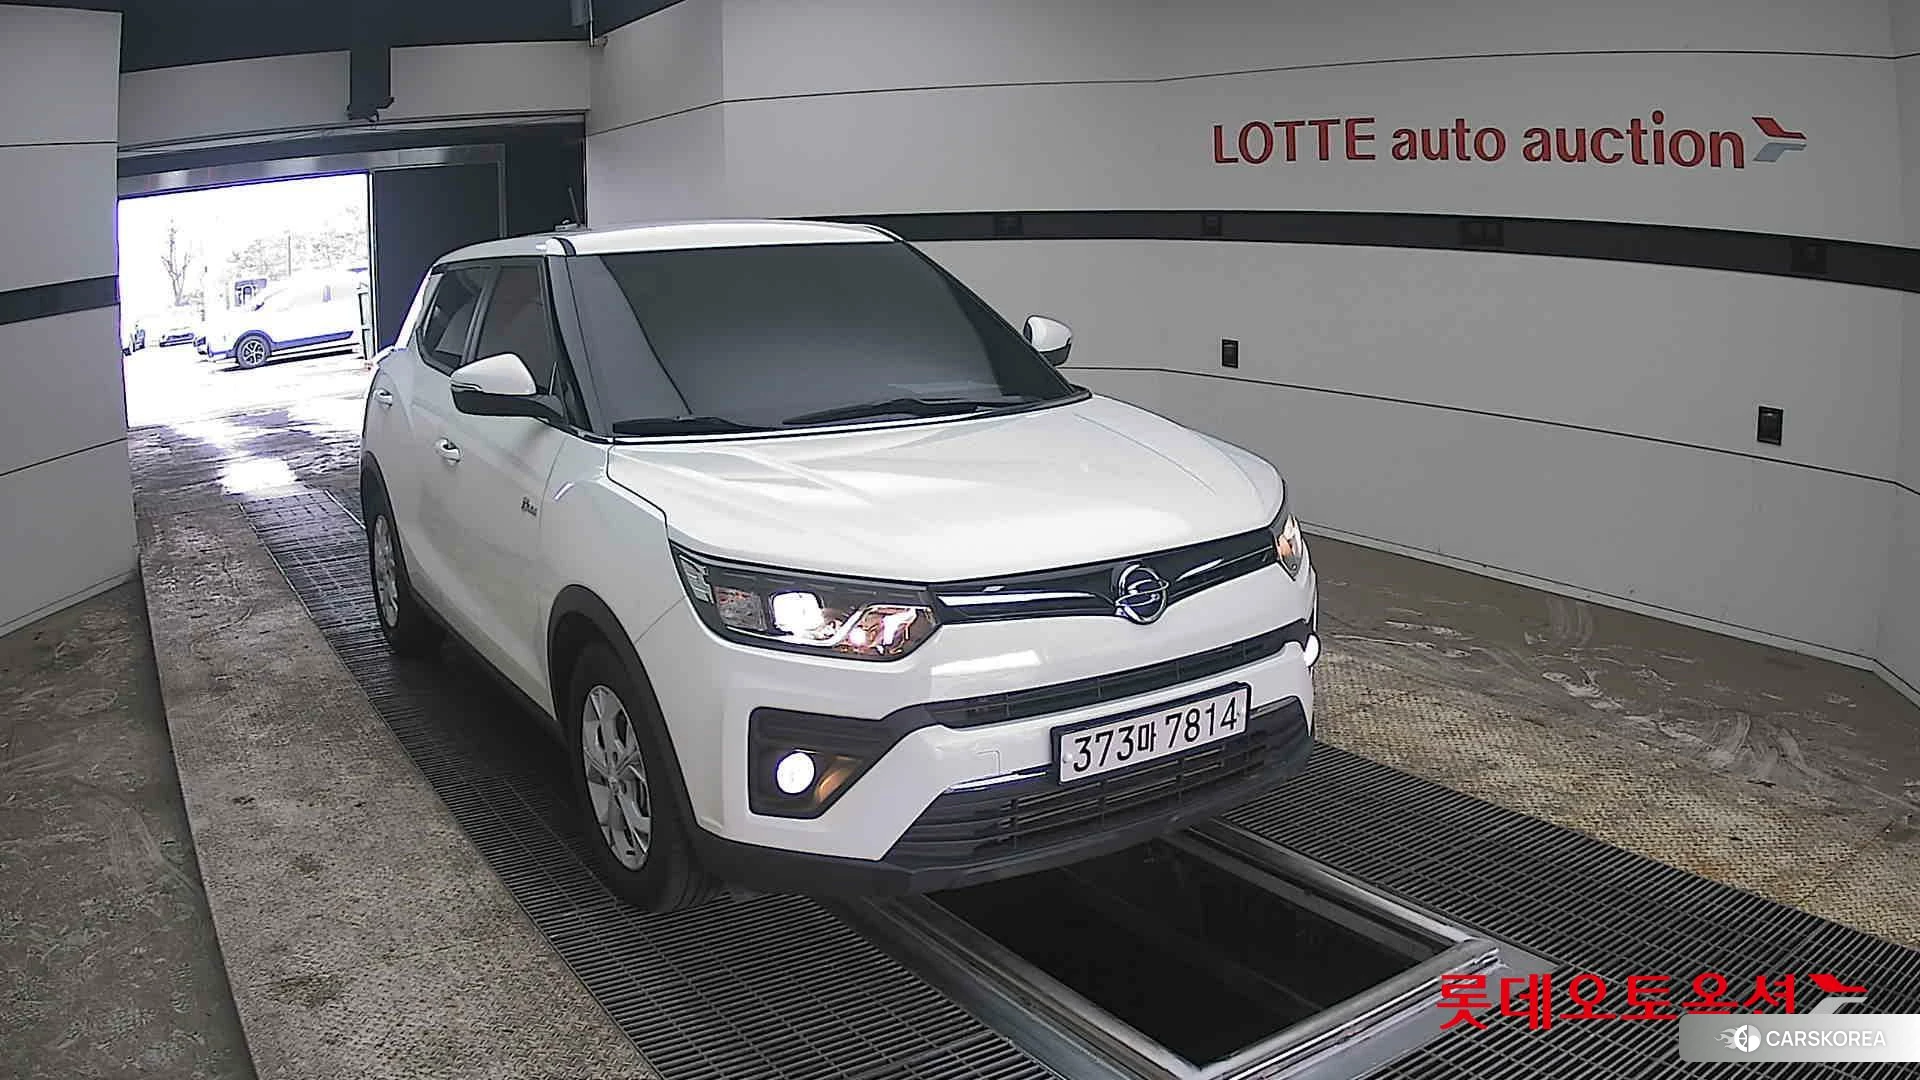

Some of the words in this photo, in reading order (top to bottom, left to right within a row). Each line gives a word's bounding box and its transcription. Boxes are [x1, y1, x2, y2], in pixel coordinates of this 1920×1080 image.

[1212, 117, 1377, 164] LOTTE
[1391, 118, 1507, 162] auto
[1522, 111, 1746, 169] auction
[1073, 721, 1157, 773] 373마
[1165, 696, 1238, 750] 7814
